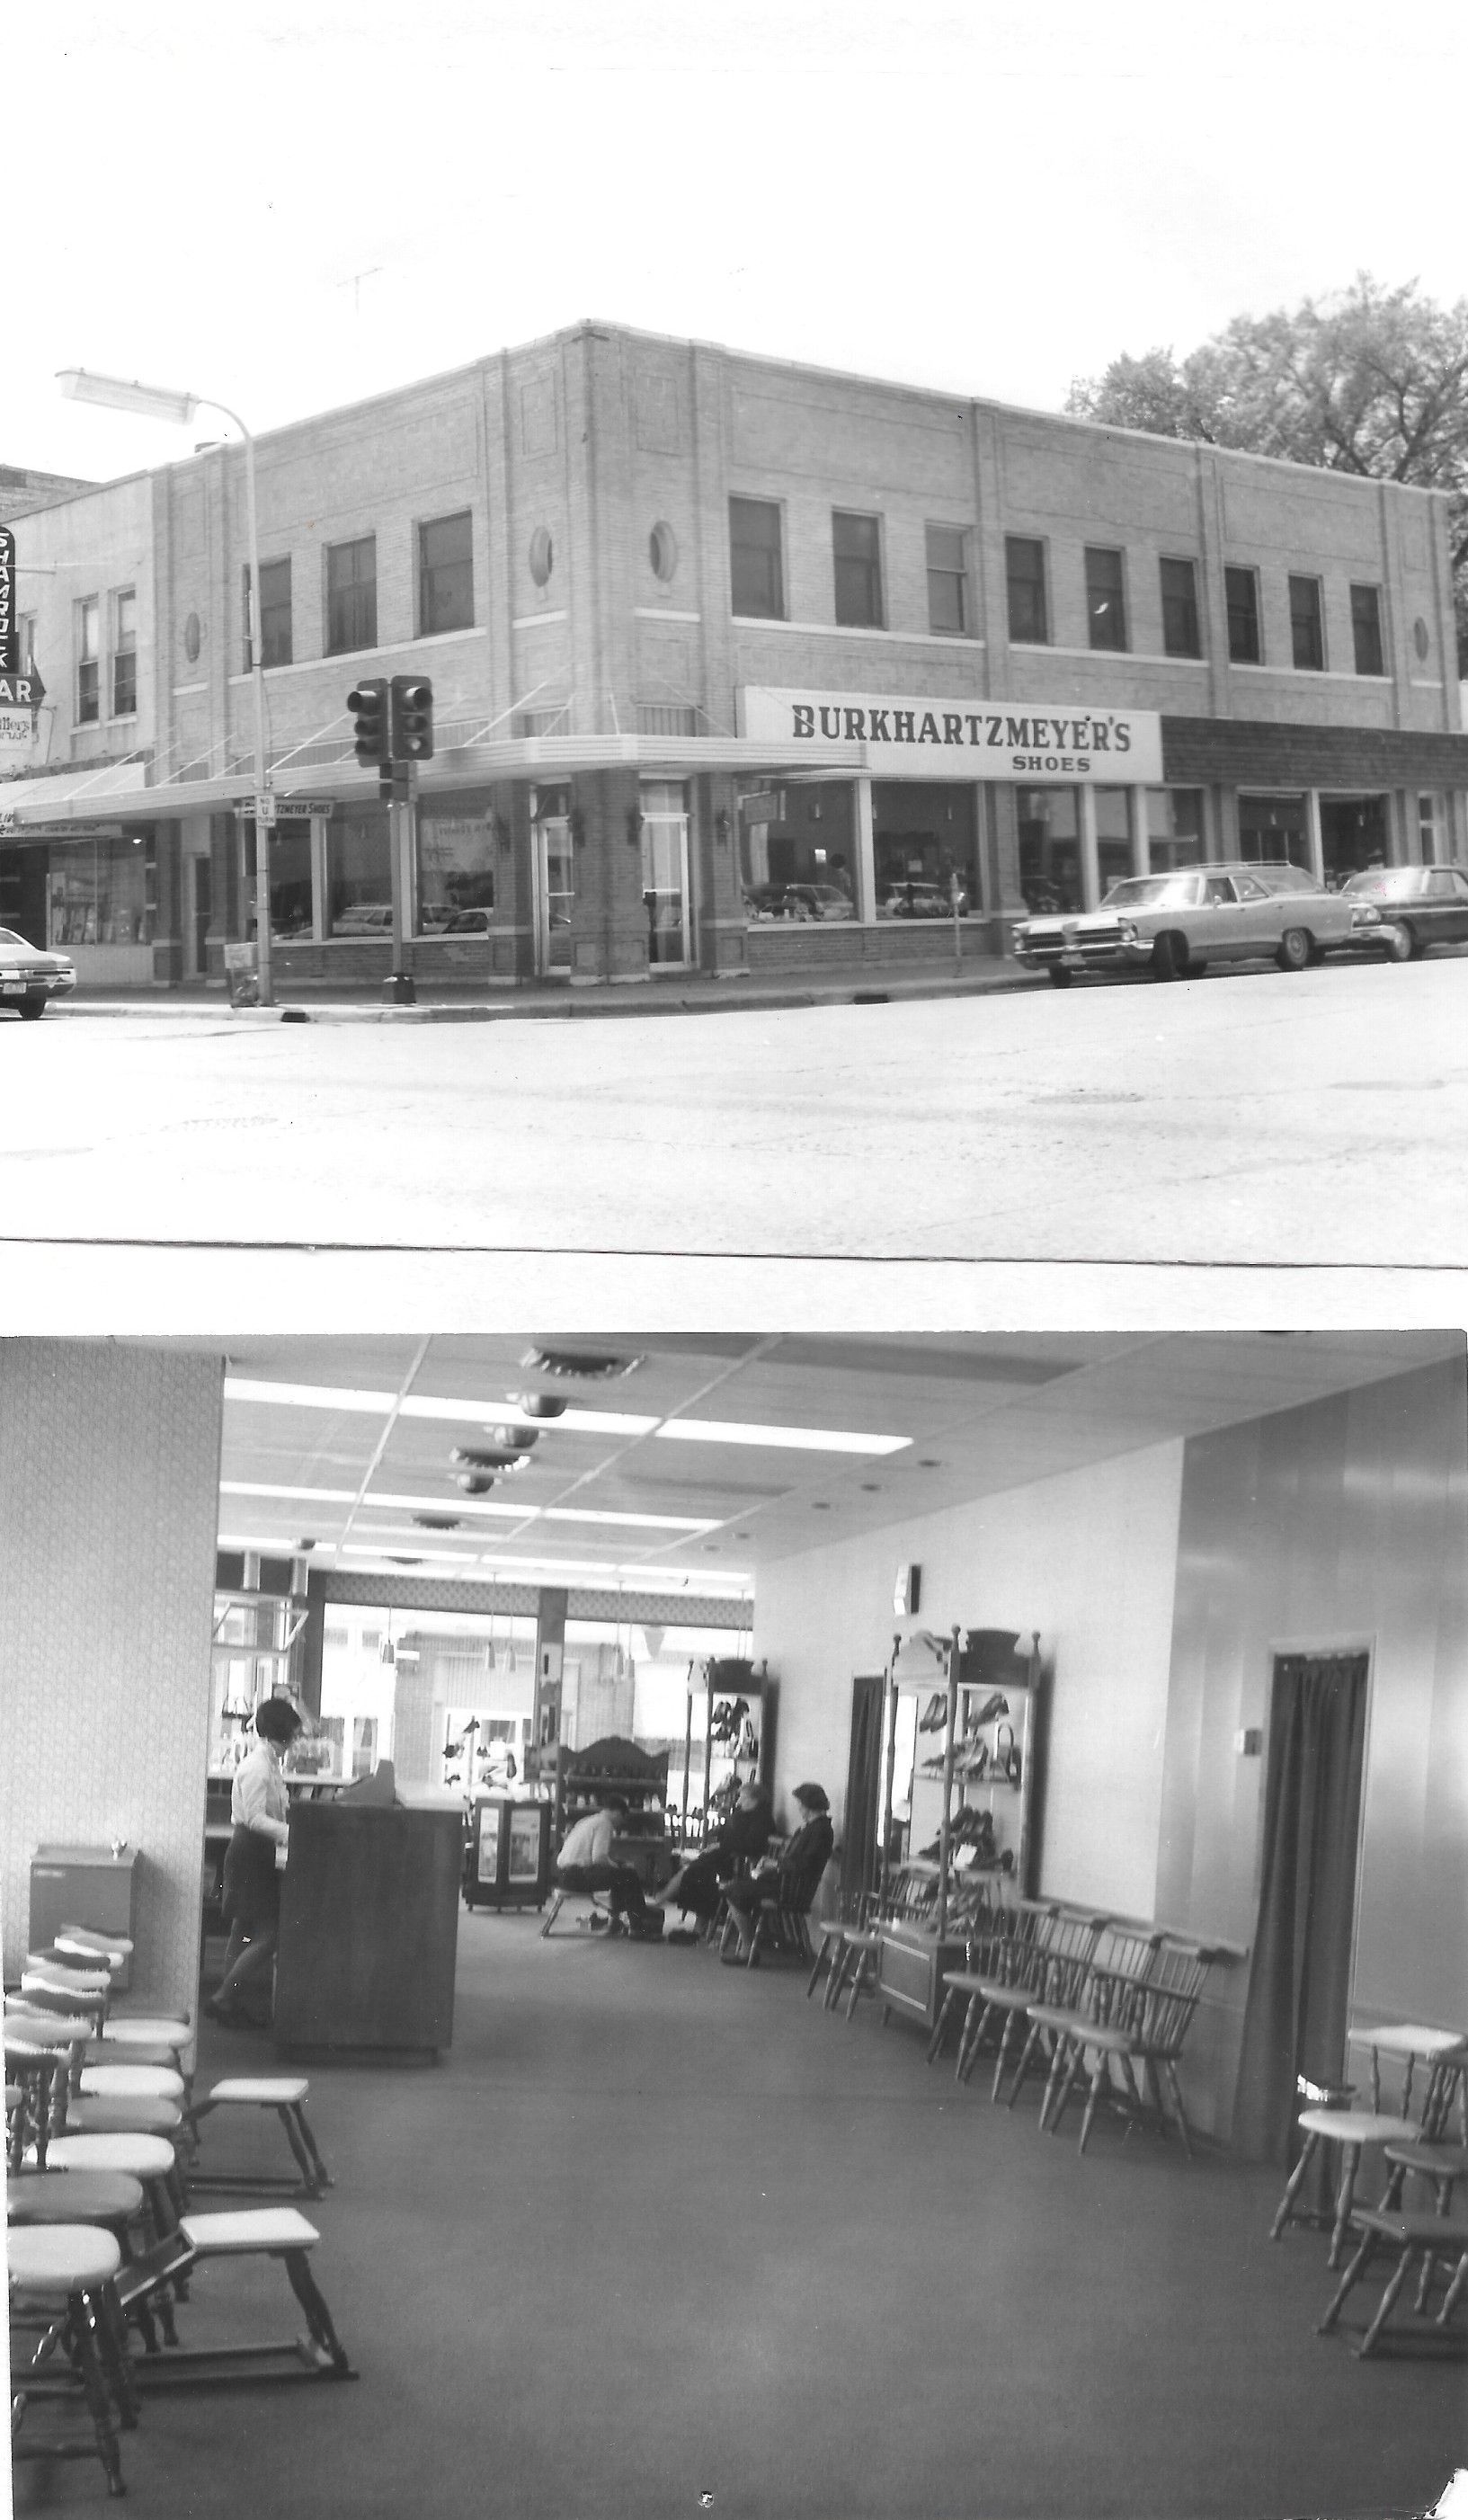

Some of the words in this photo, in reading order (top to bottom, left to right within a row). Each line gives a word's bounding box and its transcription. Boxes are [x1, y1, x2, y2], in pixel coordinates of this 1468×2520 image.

[0, 679, 31, 702] AR
[792, 704, 1132, 752] BURKHARTZMEYER'S
[1012, 755, 1090, 772] SHOES
[262, 806, 269, 815] U
[257, 815, 274, 824] TURN
